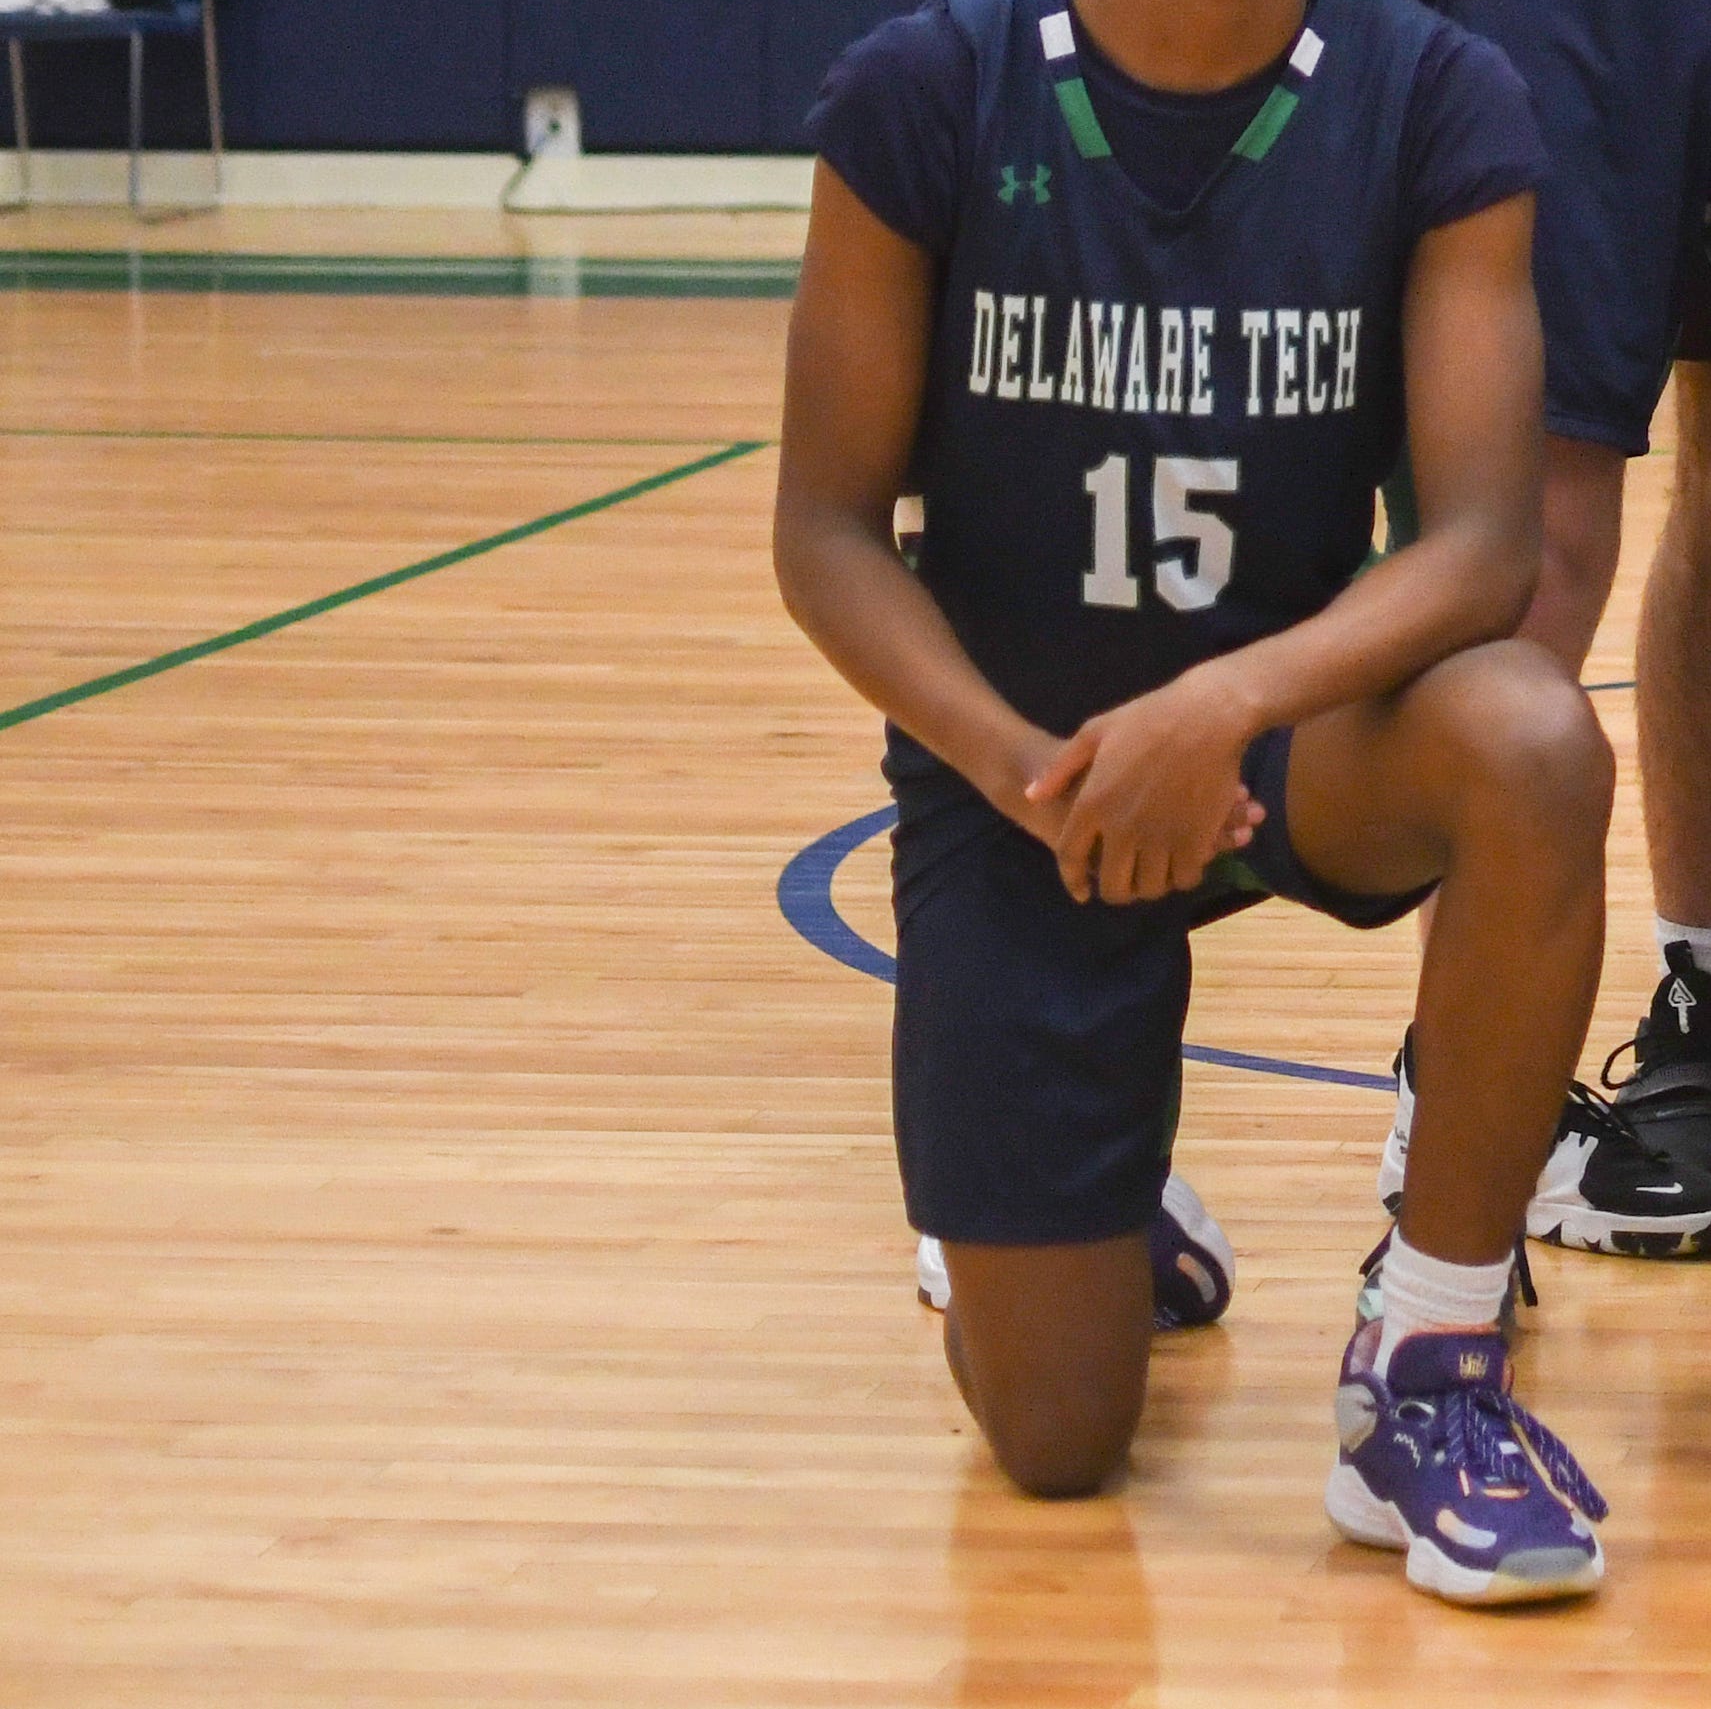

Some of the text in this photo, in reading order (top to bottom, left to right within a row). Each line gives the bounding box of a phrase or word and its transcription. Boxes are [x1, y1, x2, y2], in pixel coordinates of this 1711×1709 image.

[968, 290, 1363, 417] DELAWARE TECH
[1081, 453, 1242, 612] 15
